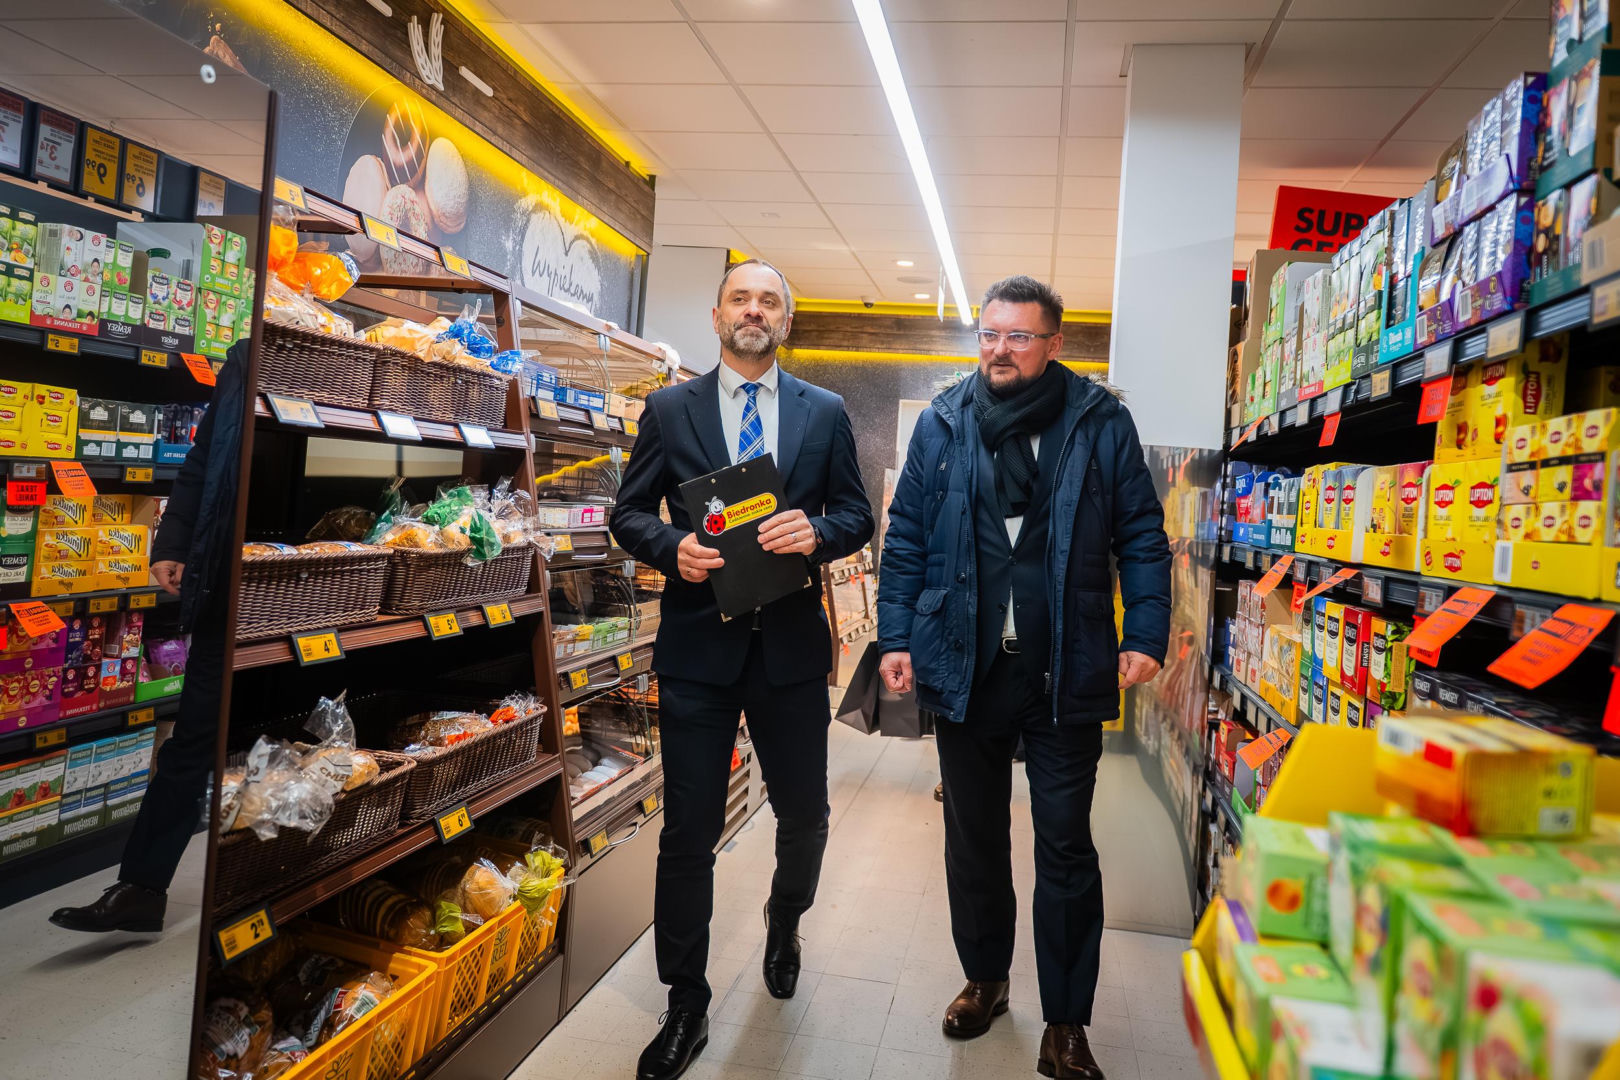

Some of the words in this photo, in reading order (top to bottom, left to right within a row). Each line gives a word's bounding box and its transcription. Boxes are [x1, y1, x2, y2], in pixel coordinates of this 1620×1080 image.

[1294, 206, 1372, 238] SUP
[1526, 374, 1538, 413] LIPTON
[1401, 487, 1418, 499] LIPTON
[1434, 489, 1454, 502] LIPTON
[1470, 487, 1494, 501] LIPTON
[726, 498, 772, 519] Biedronka
[1444, 556, 1461, 568] LIPTON
[1362, 643, 1370, 667] REMSEY
[1439, 687, 1460, 705] REMSEY
